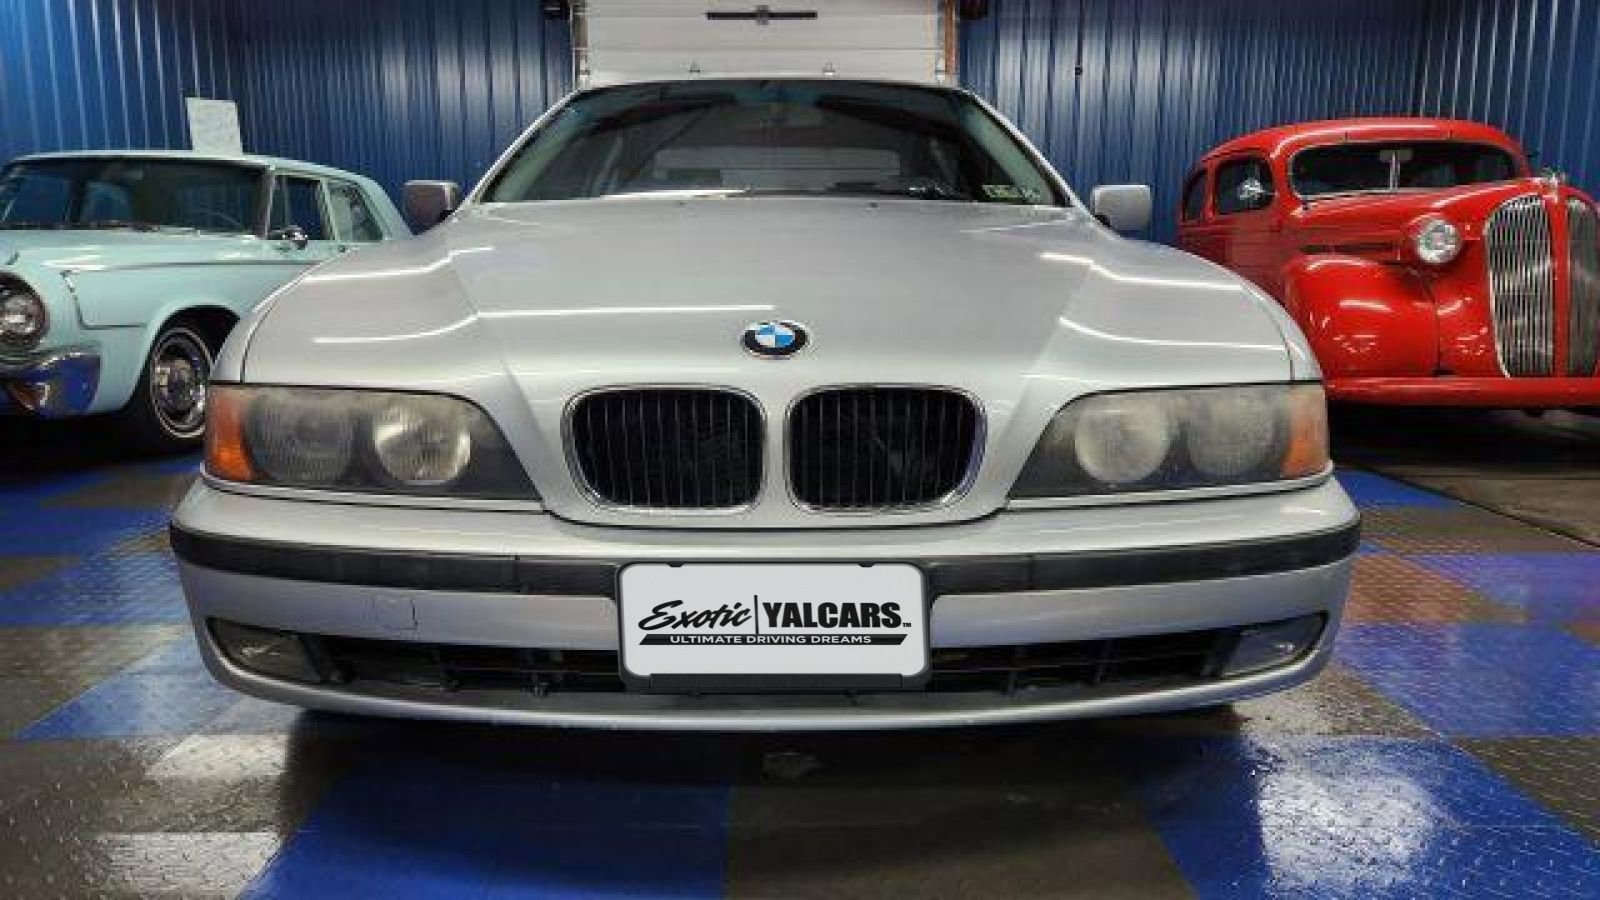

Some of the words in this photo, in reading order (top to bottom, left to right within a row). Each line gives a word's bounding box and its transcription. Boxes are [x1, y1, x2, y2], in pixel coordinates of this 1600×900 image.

[638, 600, 752, 631] Exotic
[763, 602, 902, 629] YALCARS
[670, 635, 742, 644] ULTIMATE
[746, 635, 806, 644] DRIVING
[811, 635, 872, 644] DREAMS
